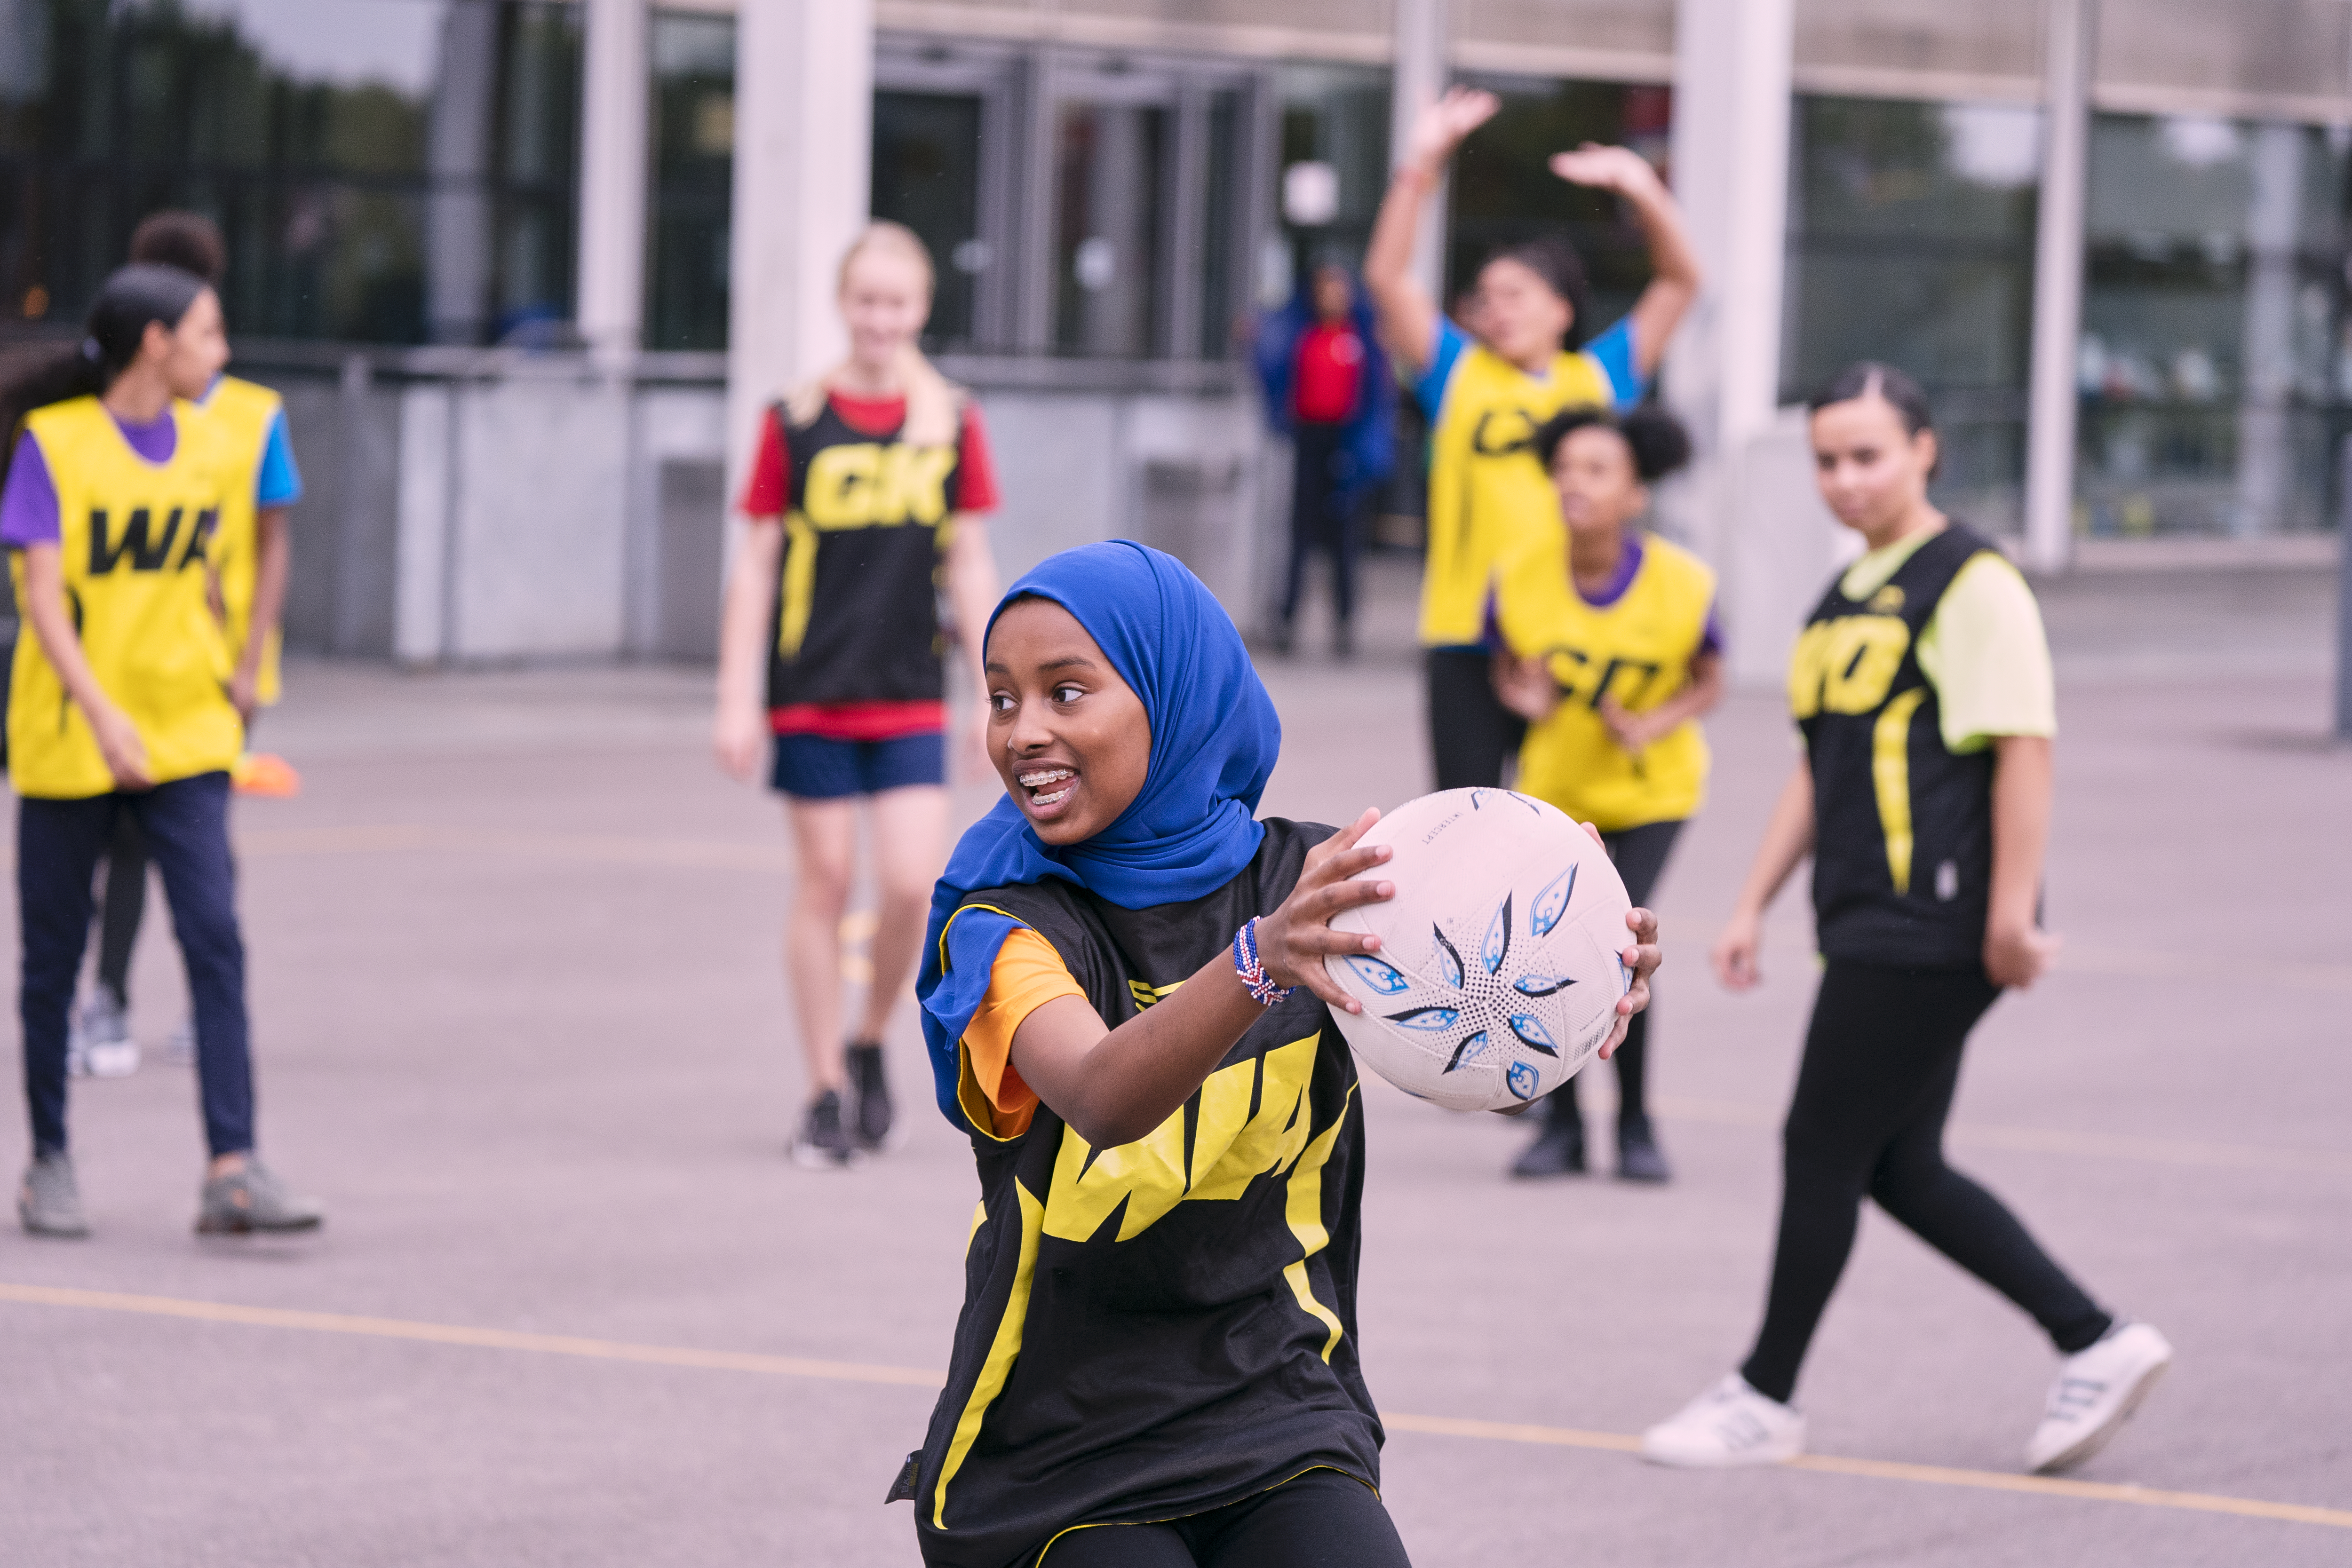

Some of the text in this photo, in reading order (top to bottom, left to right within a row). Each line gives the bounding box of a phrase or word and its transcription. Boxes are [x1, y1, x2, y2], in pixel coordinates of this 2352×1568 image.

[803, 442, 958, 531] GK
[1422, 812, 1464, 845] INTERCEPT
[1041, 1029, 1321, 1243] WA
